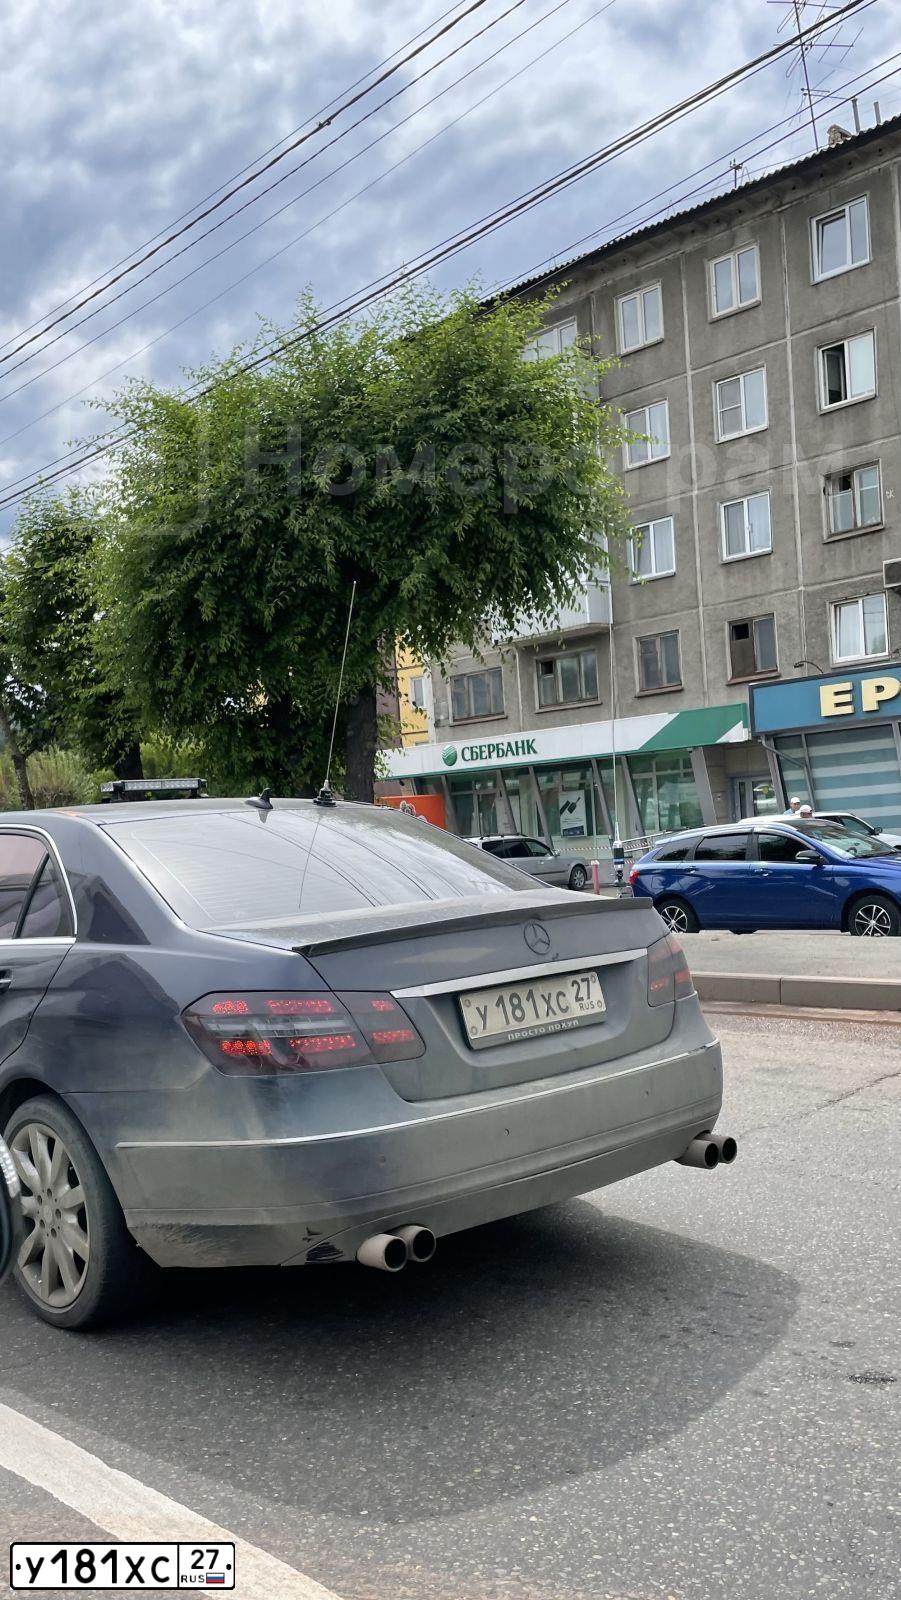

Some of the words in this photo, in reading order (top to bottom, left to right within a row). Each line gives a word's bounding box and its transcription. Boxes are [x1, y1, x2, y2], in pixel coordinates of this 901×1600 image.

[461, 738, 537, 762] СБЕРБАНК
[571, 977, 592, 1003] 27
[578, 1001, 596, 1012] RUS
